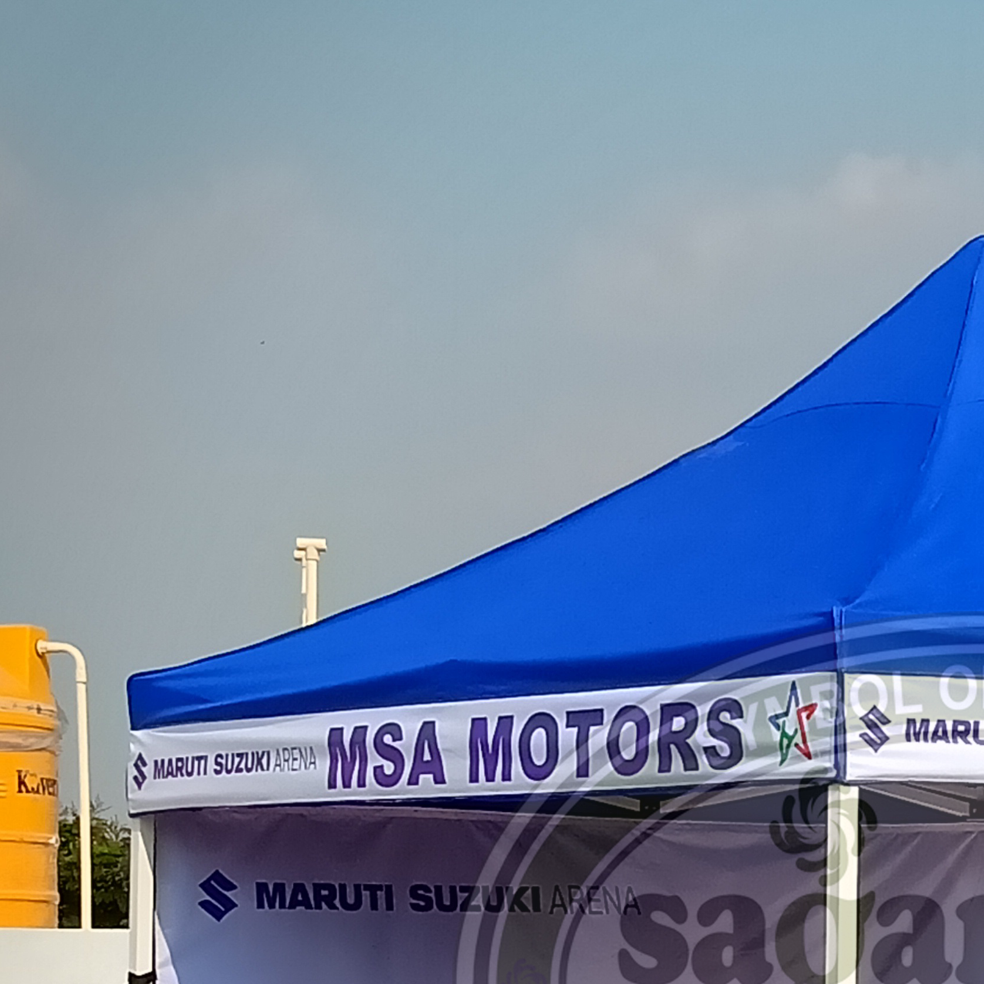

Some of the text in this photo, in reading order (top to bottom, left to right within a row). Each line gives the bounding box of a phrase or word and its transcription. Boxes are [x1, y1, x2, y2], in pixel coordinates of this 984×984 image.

[327, 697, 745, 790] MSA MOTORS
[153, 746, 317, 780] MARUTI SUZUKI ARENA
[254, 881, 642, 916] MARUTI SUZUKI ARENA
